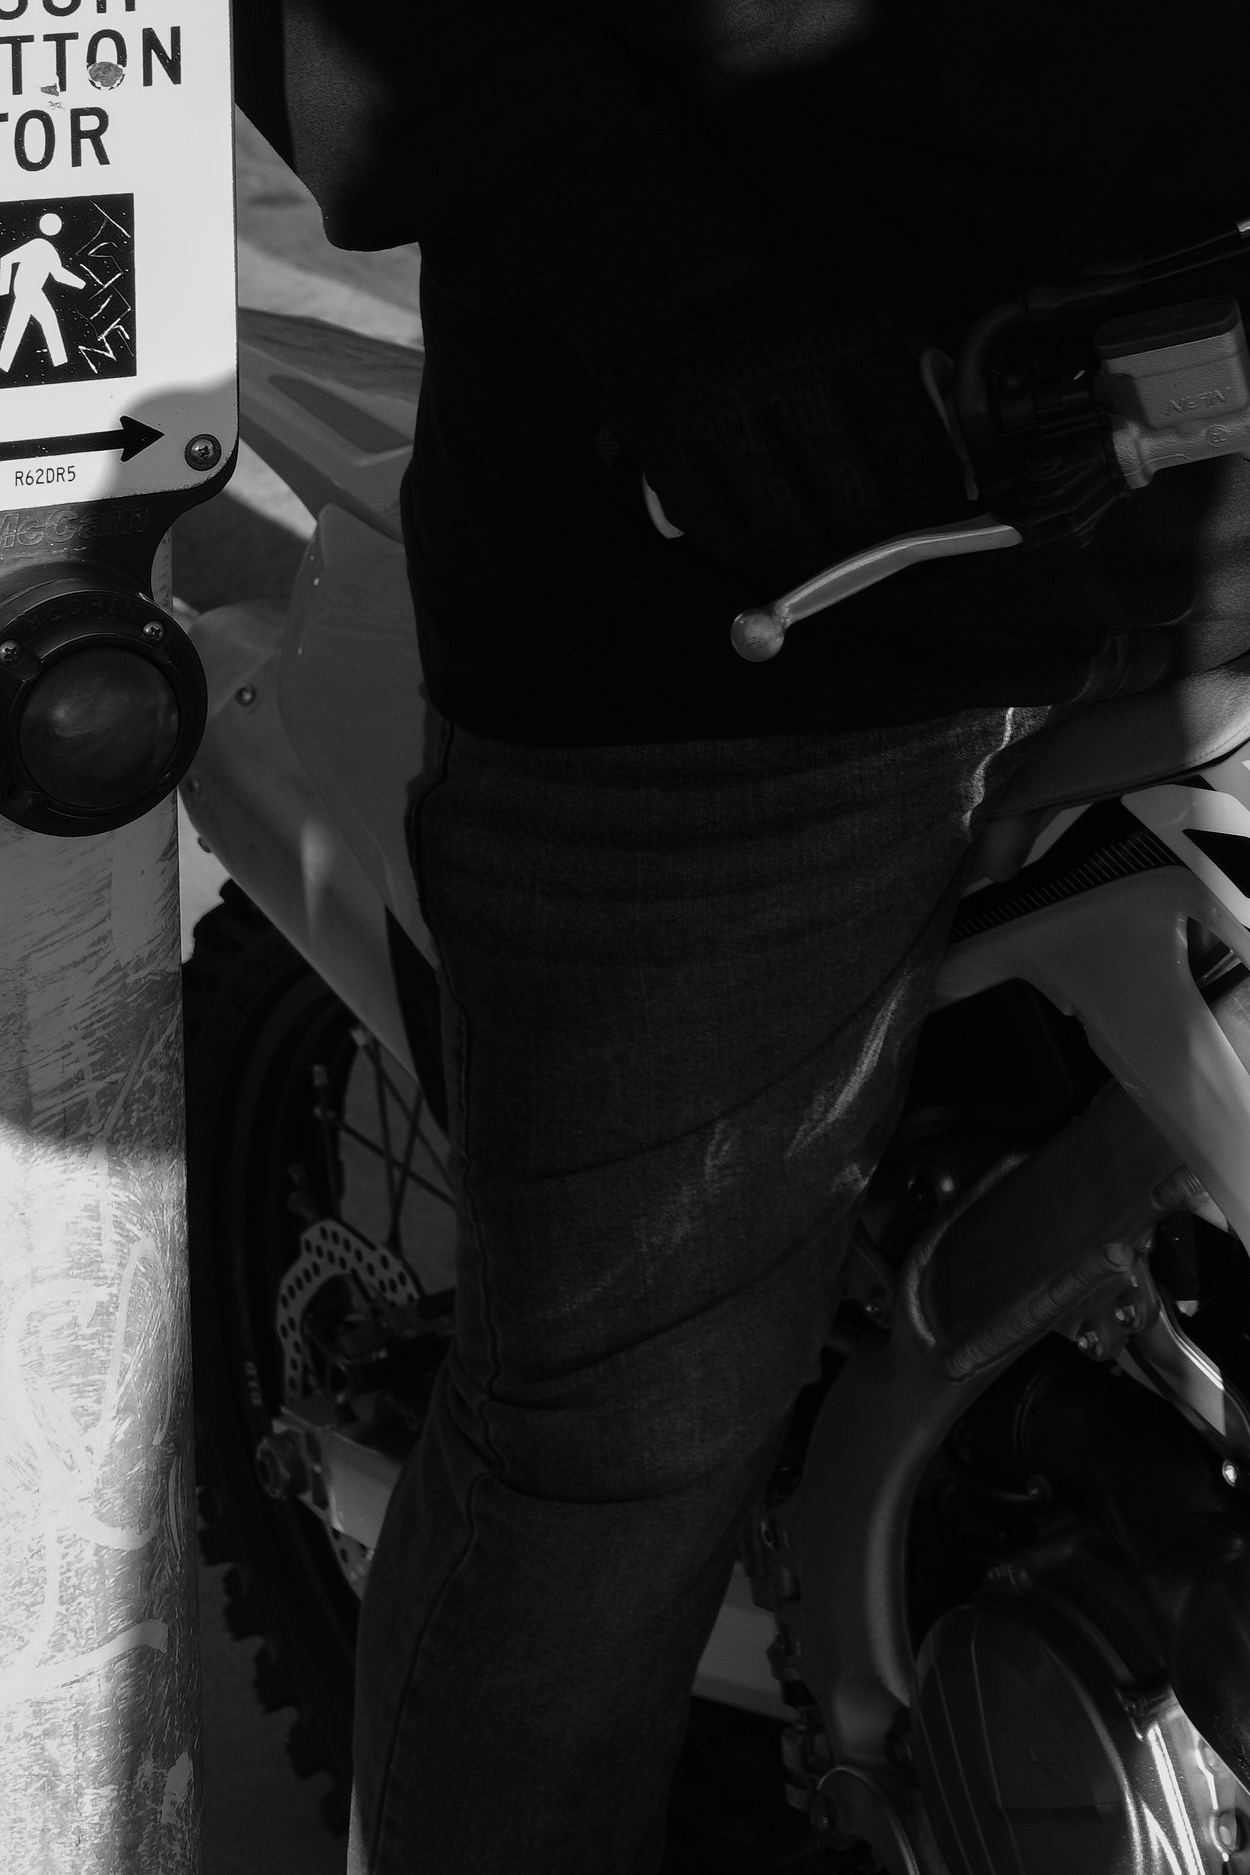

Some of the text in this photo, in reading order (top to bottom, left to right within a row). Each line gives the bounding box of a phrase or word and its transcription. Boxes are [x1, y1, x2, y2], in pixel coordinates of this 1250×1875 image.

[0, 26, 182, 95] TTON
[0, 107, 110, 171] OR
[14, 465, 77, 487] R62DR5
